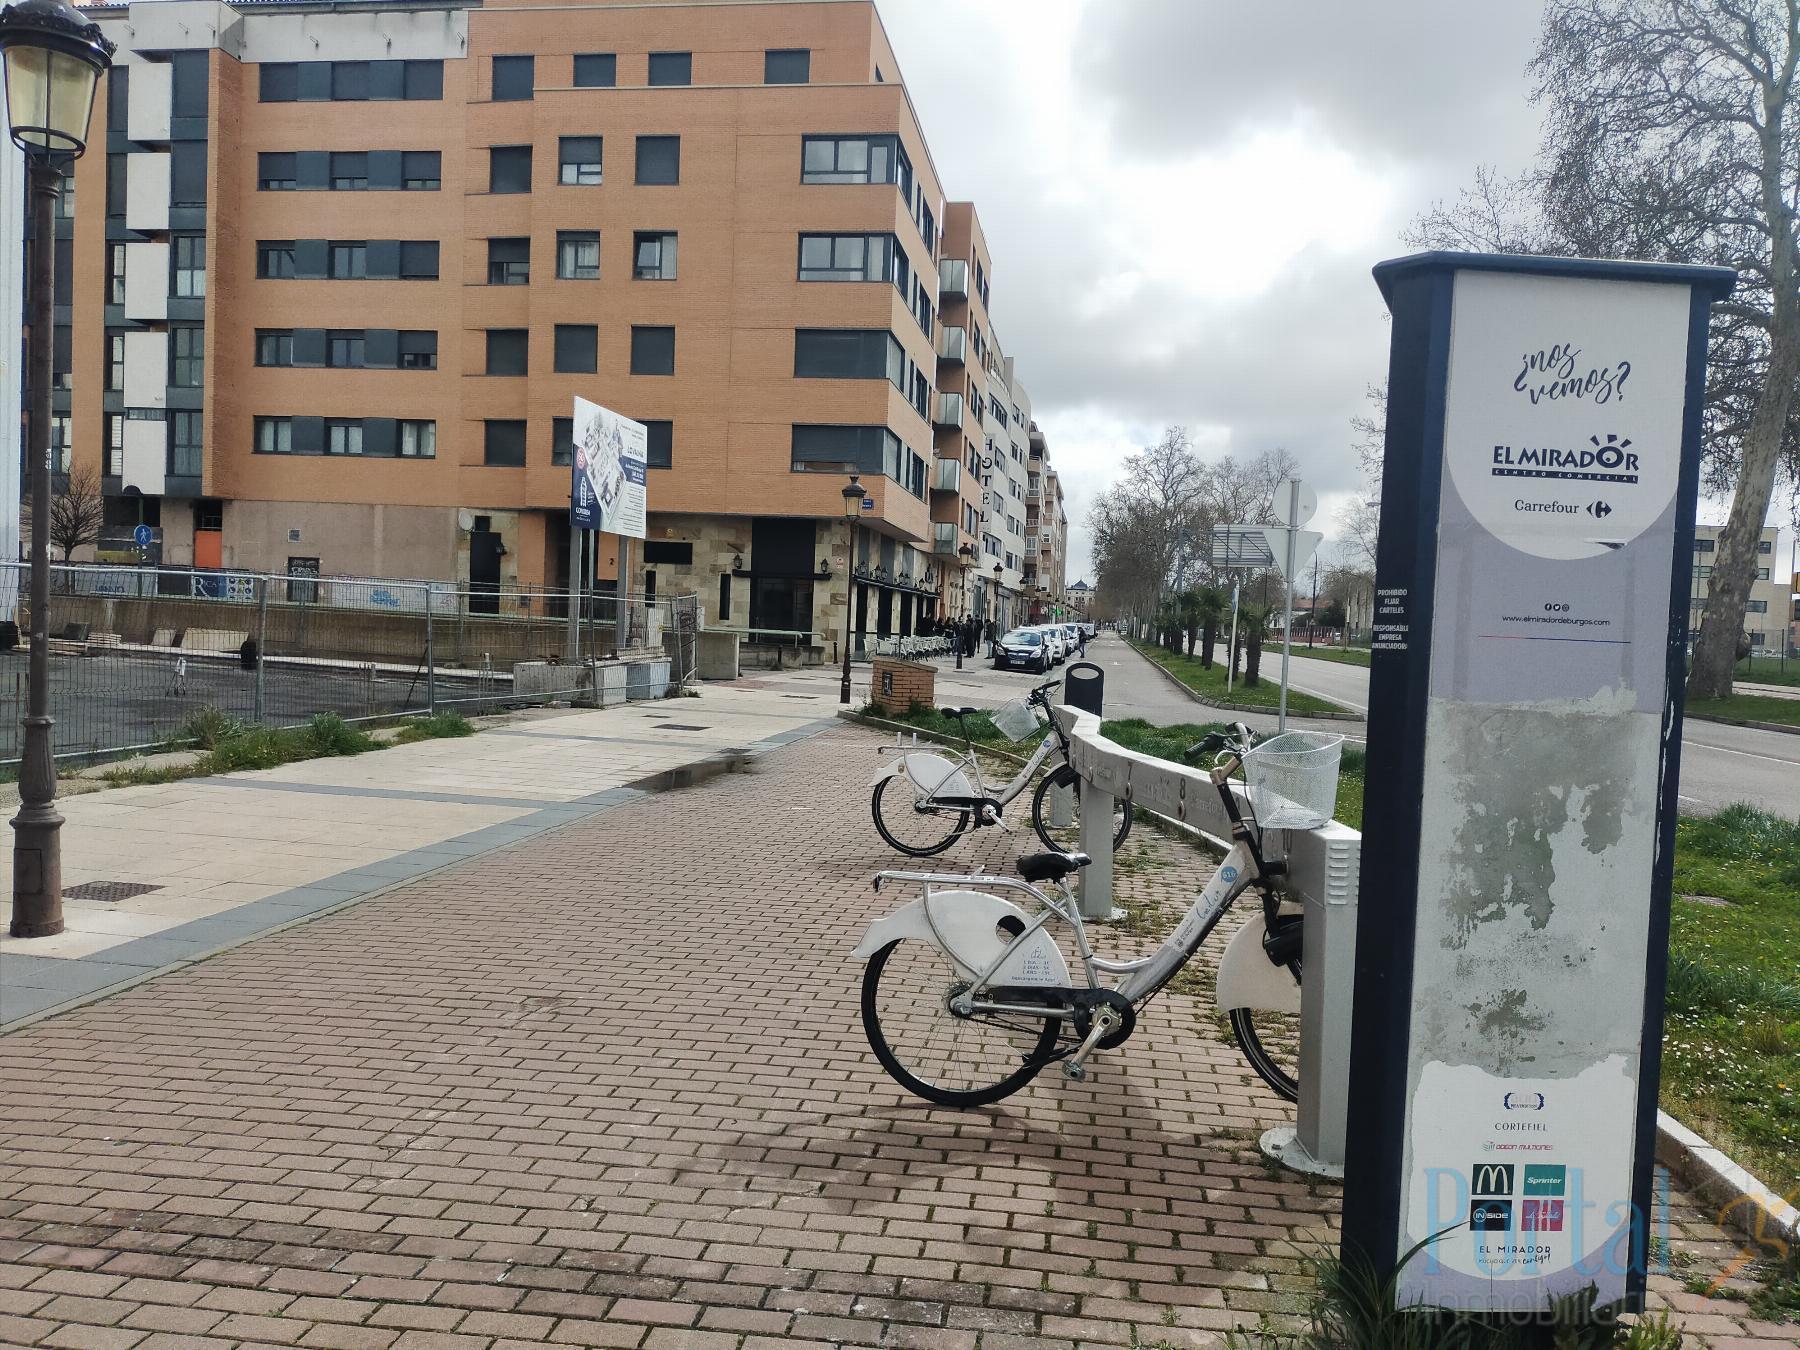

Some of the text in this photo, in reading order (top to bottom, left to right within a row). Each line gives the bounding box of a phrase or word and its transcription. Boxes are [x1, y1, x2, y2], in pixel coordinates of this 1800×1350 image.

[1514, 343, 1582, 392] ¿nos
[1530, 361, 1631, 404] vemos?
[1493, 445, 1639, 471] EL MIRADOR
[980, 438, 993, 522] HOTEL
[1495, 469, 1637, 482] CENTRO COMERCIAL
[1514, 499, 1580, 514] Carrefour
[1502, 615, 1611, 626] www.elmiradordeburgos.com
[1180, 777, 1186, 800] 8
[1494, 1122, 1547, 1132] CORTEFIEL
[1527, 1176, 1562, 1185] Sprinter
[1479, 1245, 1551, 1254] EL MIRADOR
